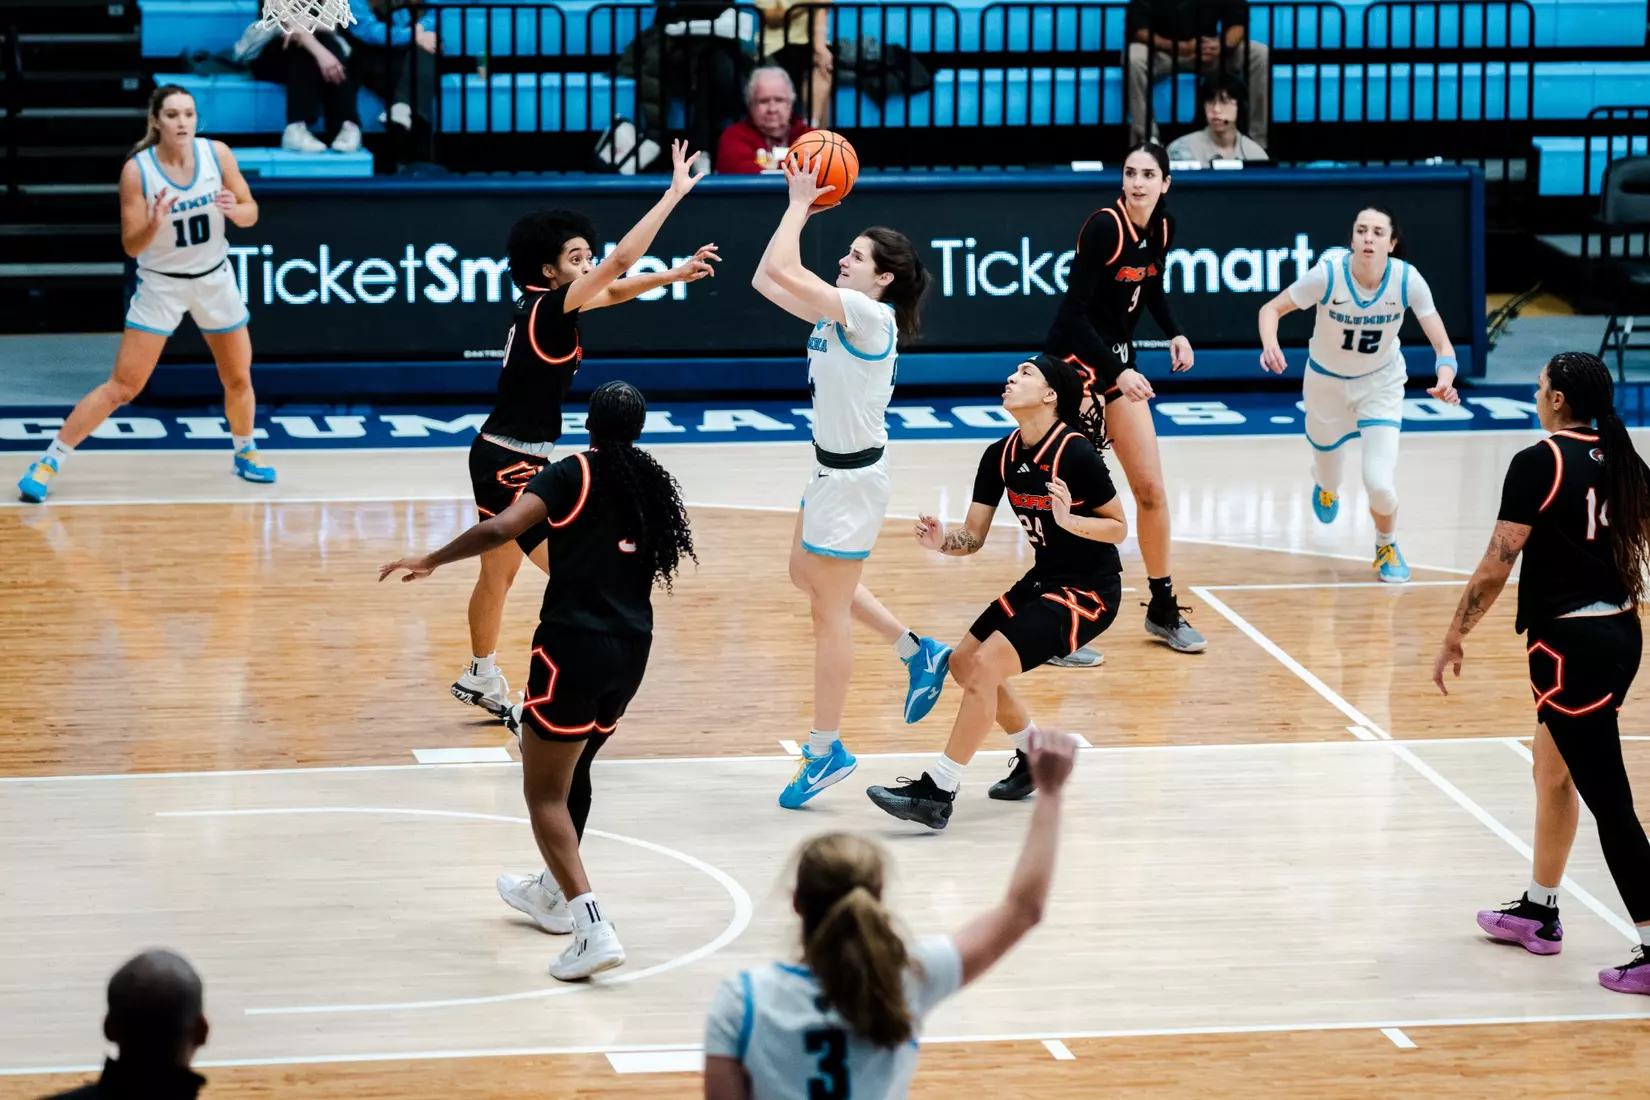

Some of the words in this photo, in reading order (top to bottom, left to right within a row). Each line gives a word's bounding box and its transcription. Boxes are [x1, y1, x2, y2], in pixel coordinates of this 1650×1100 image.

[172, 213, 211, 248] 10
[227, 243, 694, 304] TicketSmer
[1128, 285, 1141, 313] 9
[1328, 309, 1401, 326] COLUMBIA
[1341, 328, 1384, 355] 12
[1018, 514, 1047, 547] 24
[804, 1027, 851, 1100] 3
